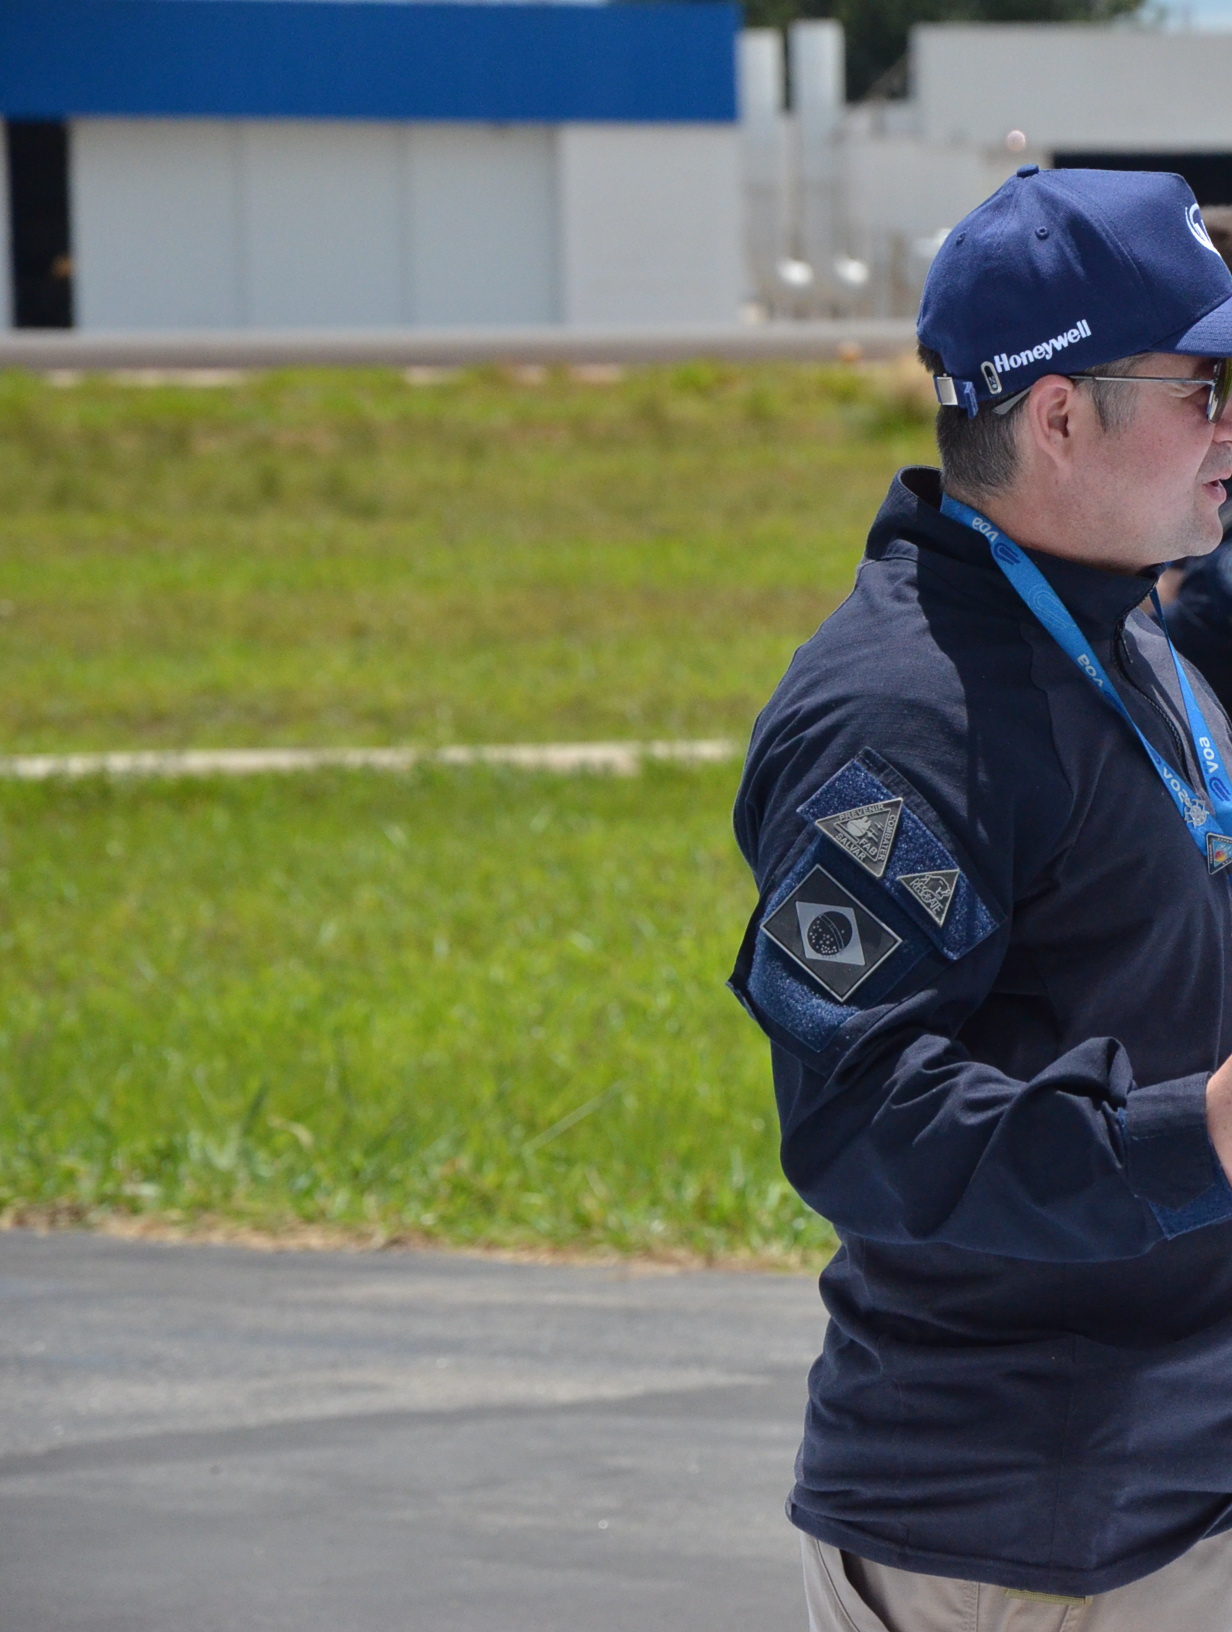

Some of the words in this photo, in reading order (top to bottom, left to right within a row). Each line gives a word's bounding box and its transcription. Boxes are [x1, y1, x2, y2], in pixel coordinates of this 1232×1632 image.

[993, 319, 1092, 373] Honeywell
[1077, 654, 1104, 688] voa
[1199, 736, 1219, 773] voa
[838, 804, 886, 821] PREVENIR
[836, 833, 867, 861] SALVAR
[858, 838, 878, 856] FAB
[877, 814, 897, 861] COMBATER
